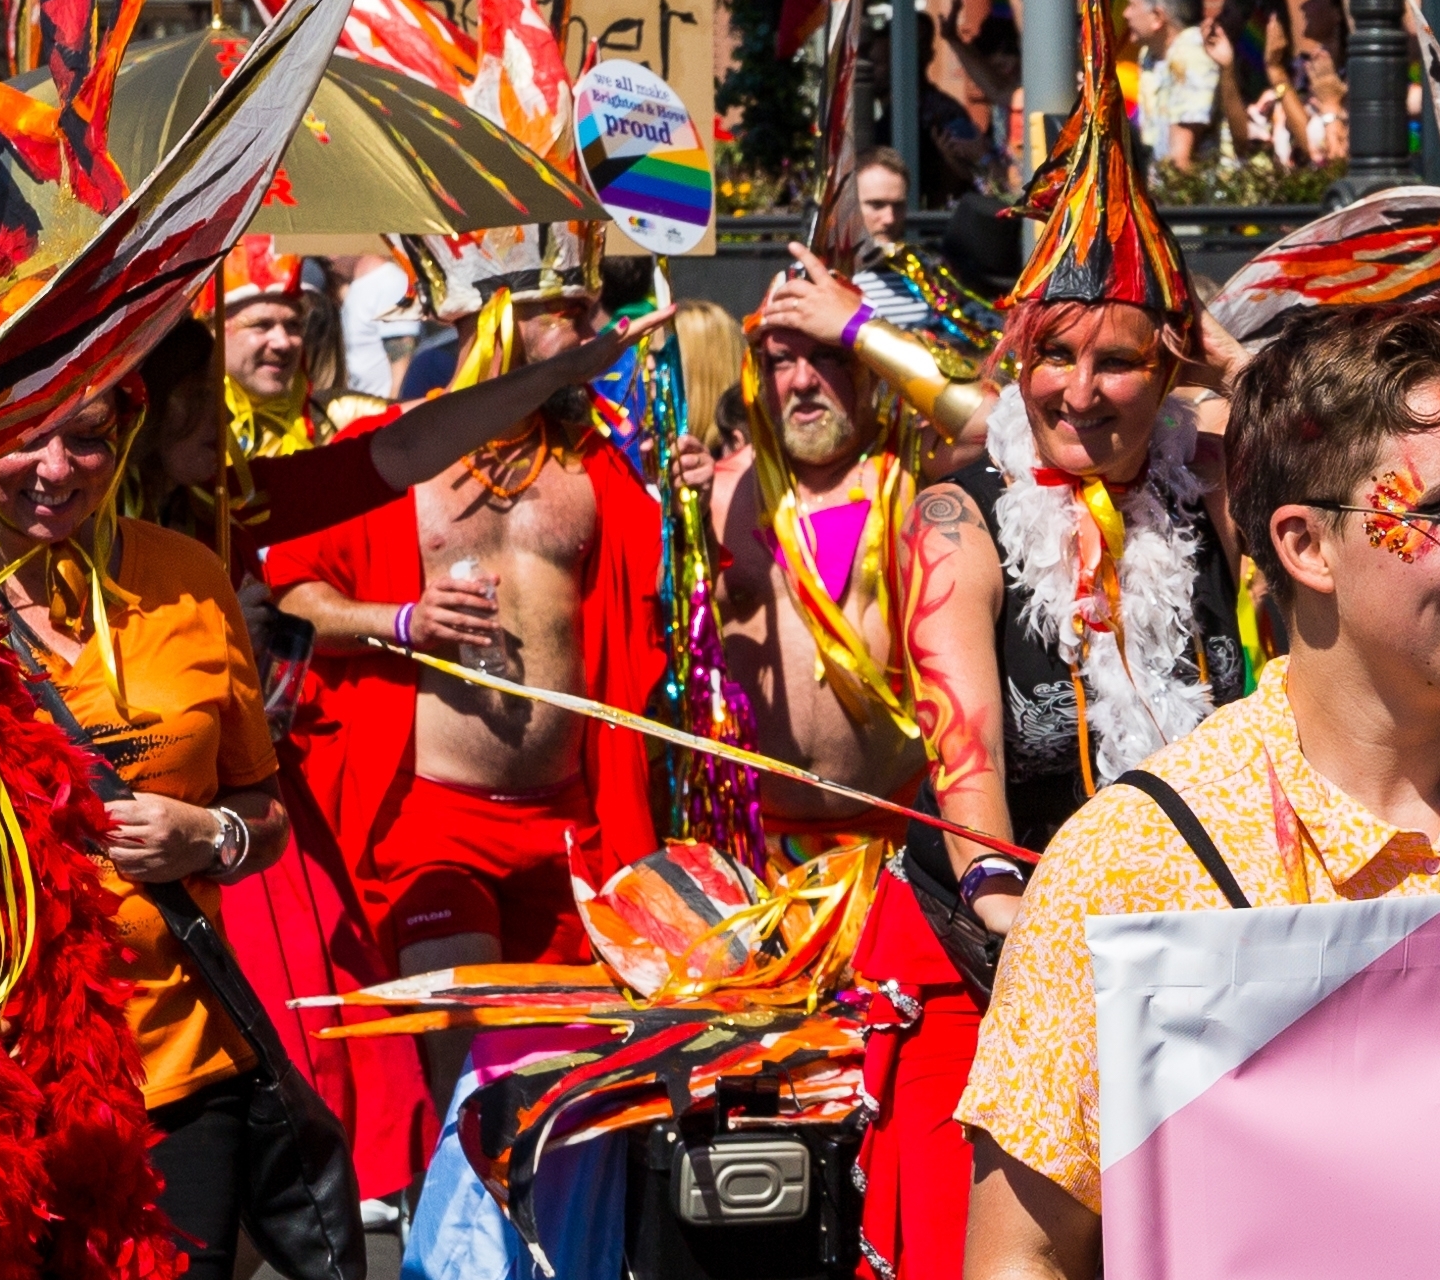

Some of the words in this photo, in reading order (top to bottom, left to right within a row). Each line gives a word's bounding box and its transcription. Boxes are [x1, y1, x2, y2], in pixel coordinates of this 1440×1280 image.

[615, 76, 633, 93] all
[636, 83, 671, 102] make
[591, 88, 645, 113] Brighton
[657, 105, 687, 124] Hove
[603, 113, 673, 146] proud
